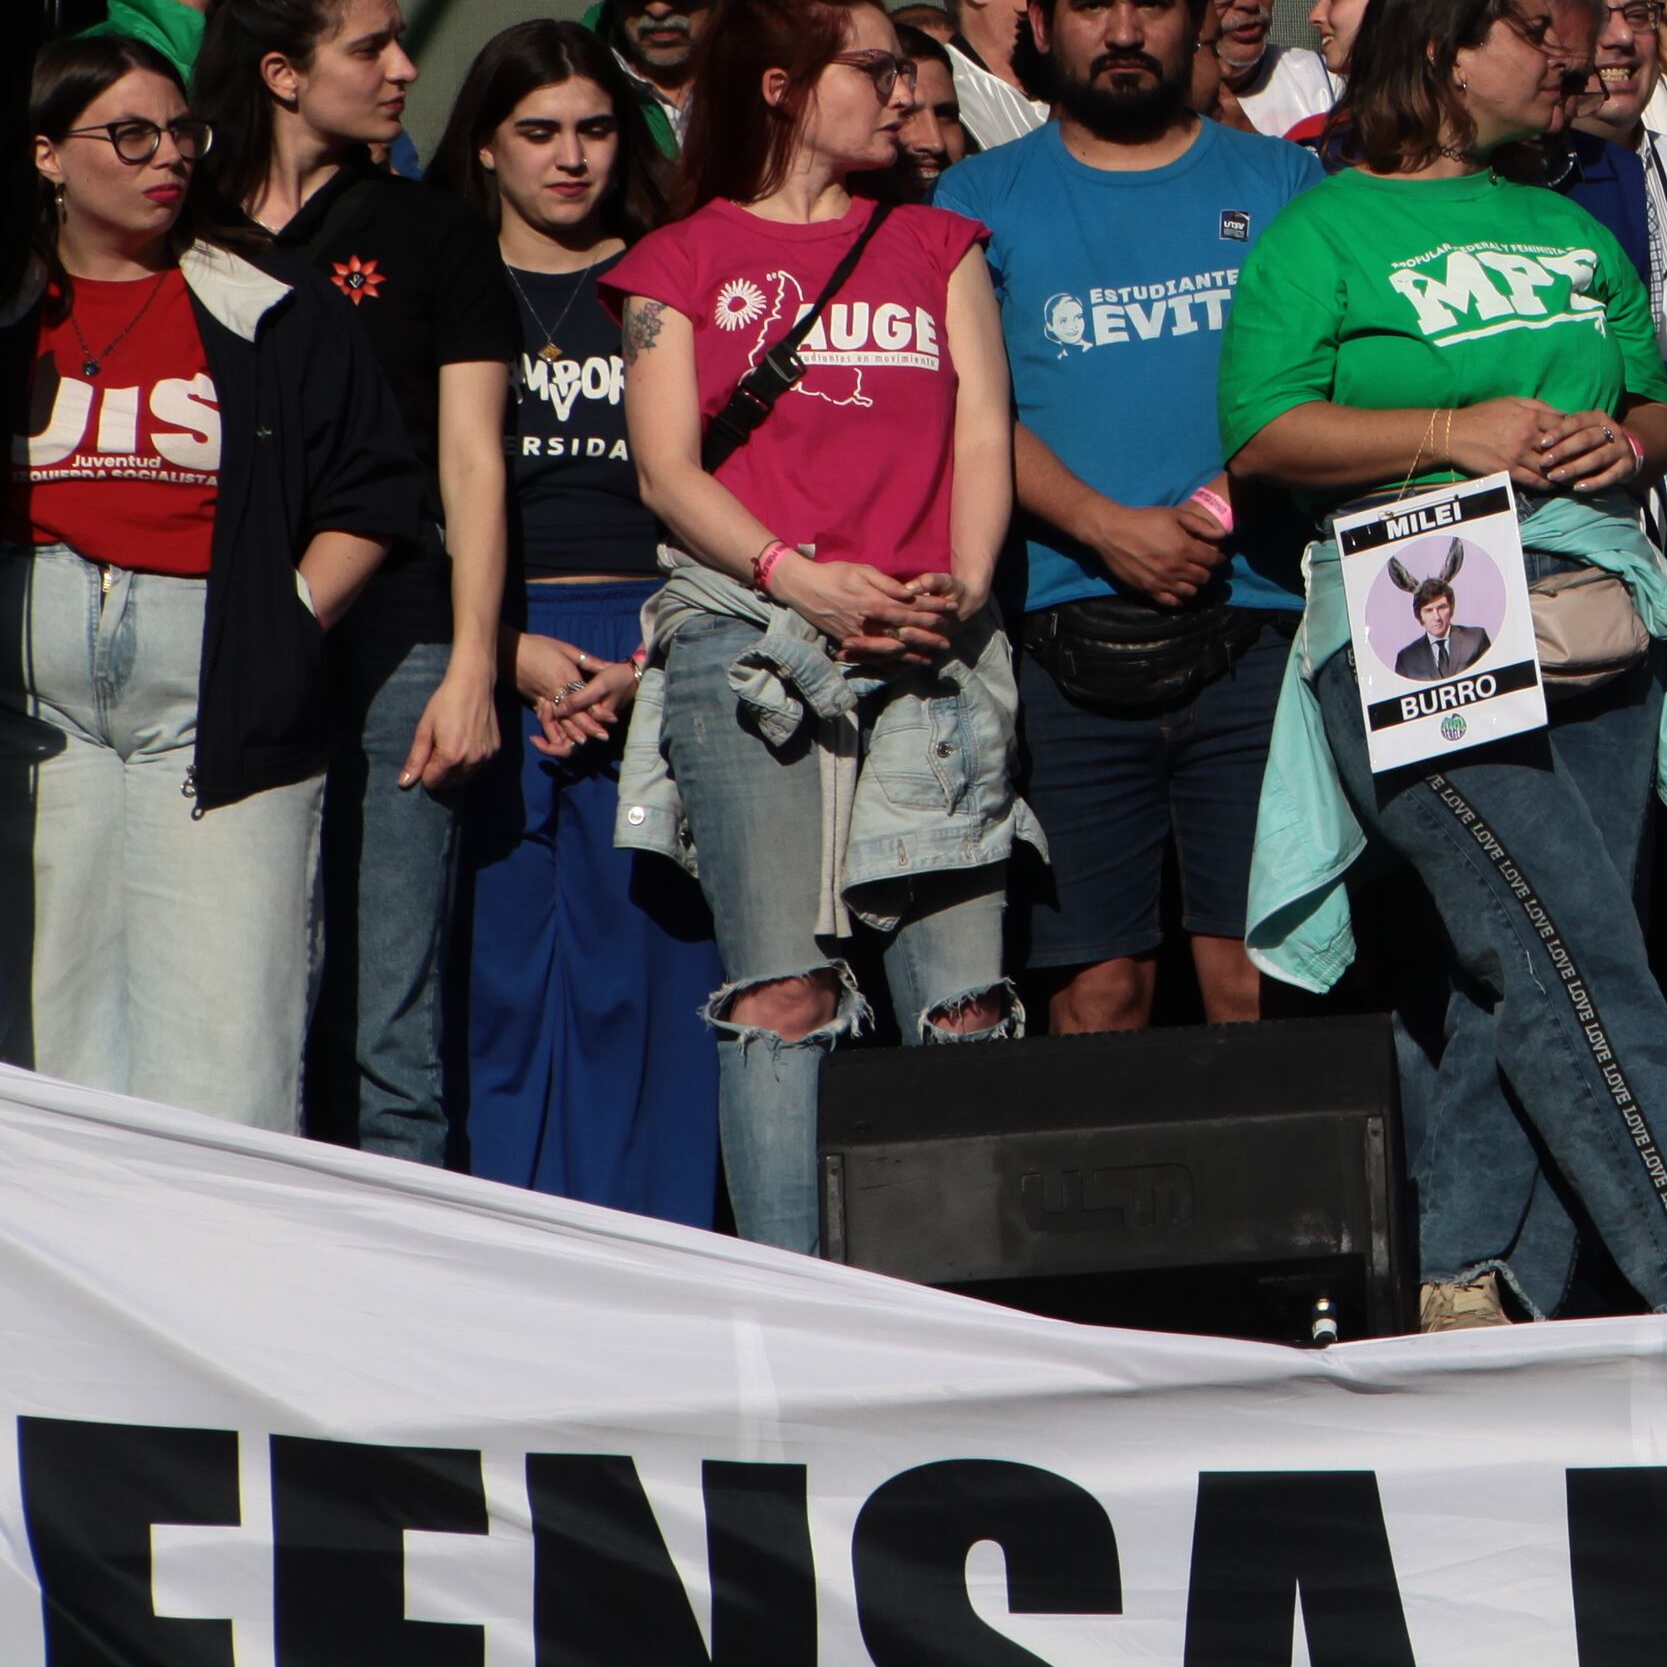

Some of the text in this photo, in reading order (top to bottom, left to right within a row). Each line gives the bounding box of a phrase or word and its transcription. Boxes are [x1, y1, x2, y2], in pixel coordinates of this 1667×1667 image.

[1090, 269, 1240, 304] ESTUDIANTE
[792, 302, 939, 356] AUGE
[1092, 288, 1232, 346] EVIT
[857, 355, 869, 364] en
[12, 372, 223, 471] JIS
[72, 454, 161, 468] Juventud
[110, 470, 218, 486] SOCIALISTA
[1386, 501, 1463, 540] MILEI
[1400, 675, 1497, 721] BURRO
[1440, 788, 1477, 824] LOVE
[1471, 823, 1505, 861] LOVE
[1498, 859, 1531, 899] LOVE
[1524, 898, 1555, 939] LOVE
[1546, 939, 1576, 979] LOVE
[1567, 980, 1594, 1021] LOVE
[1585, 1022, 1613, 1063] LOVE
[1602, 1063, 1632, 1106] LOVE
[1622, 1104, 1650, 1147] LOVE
